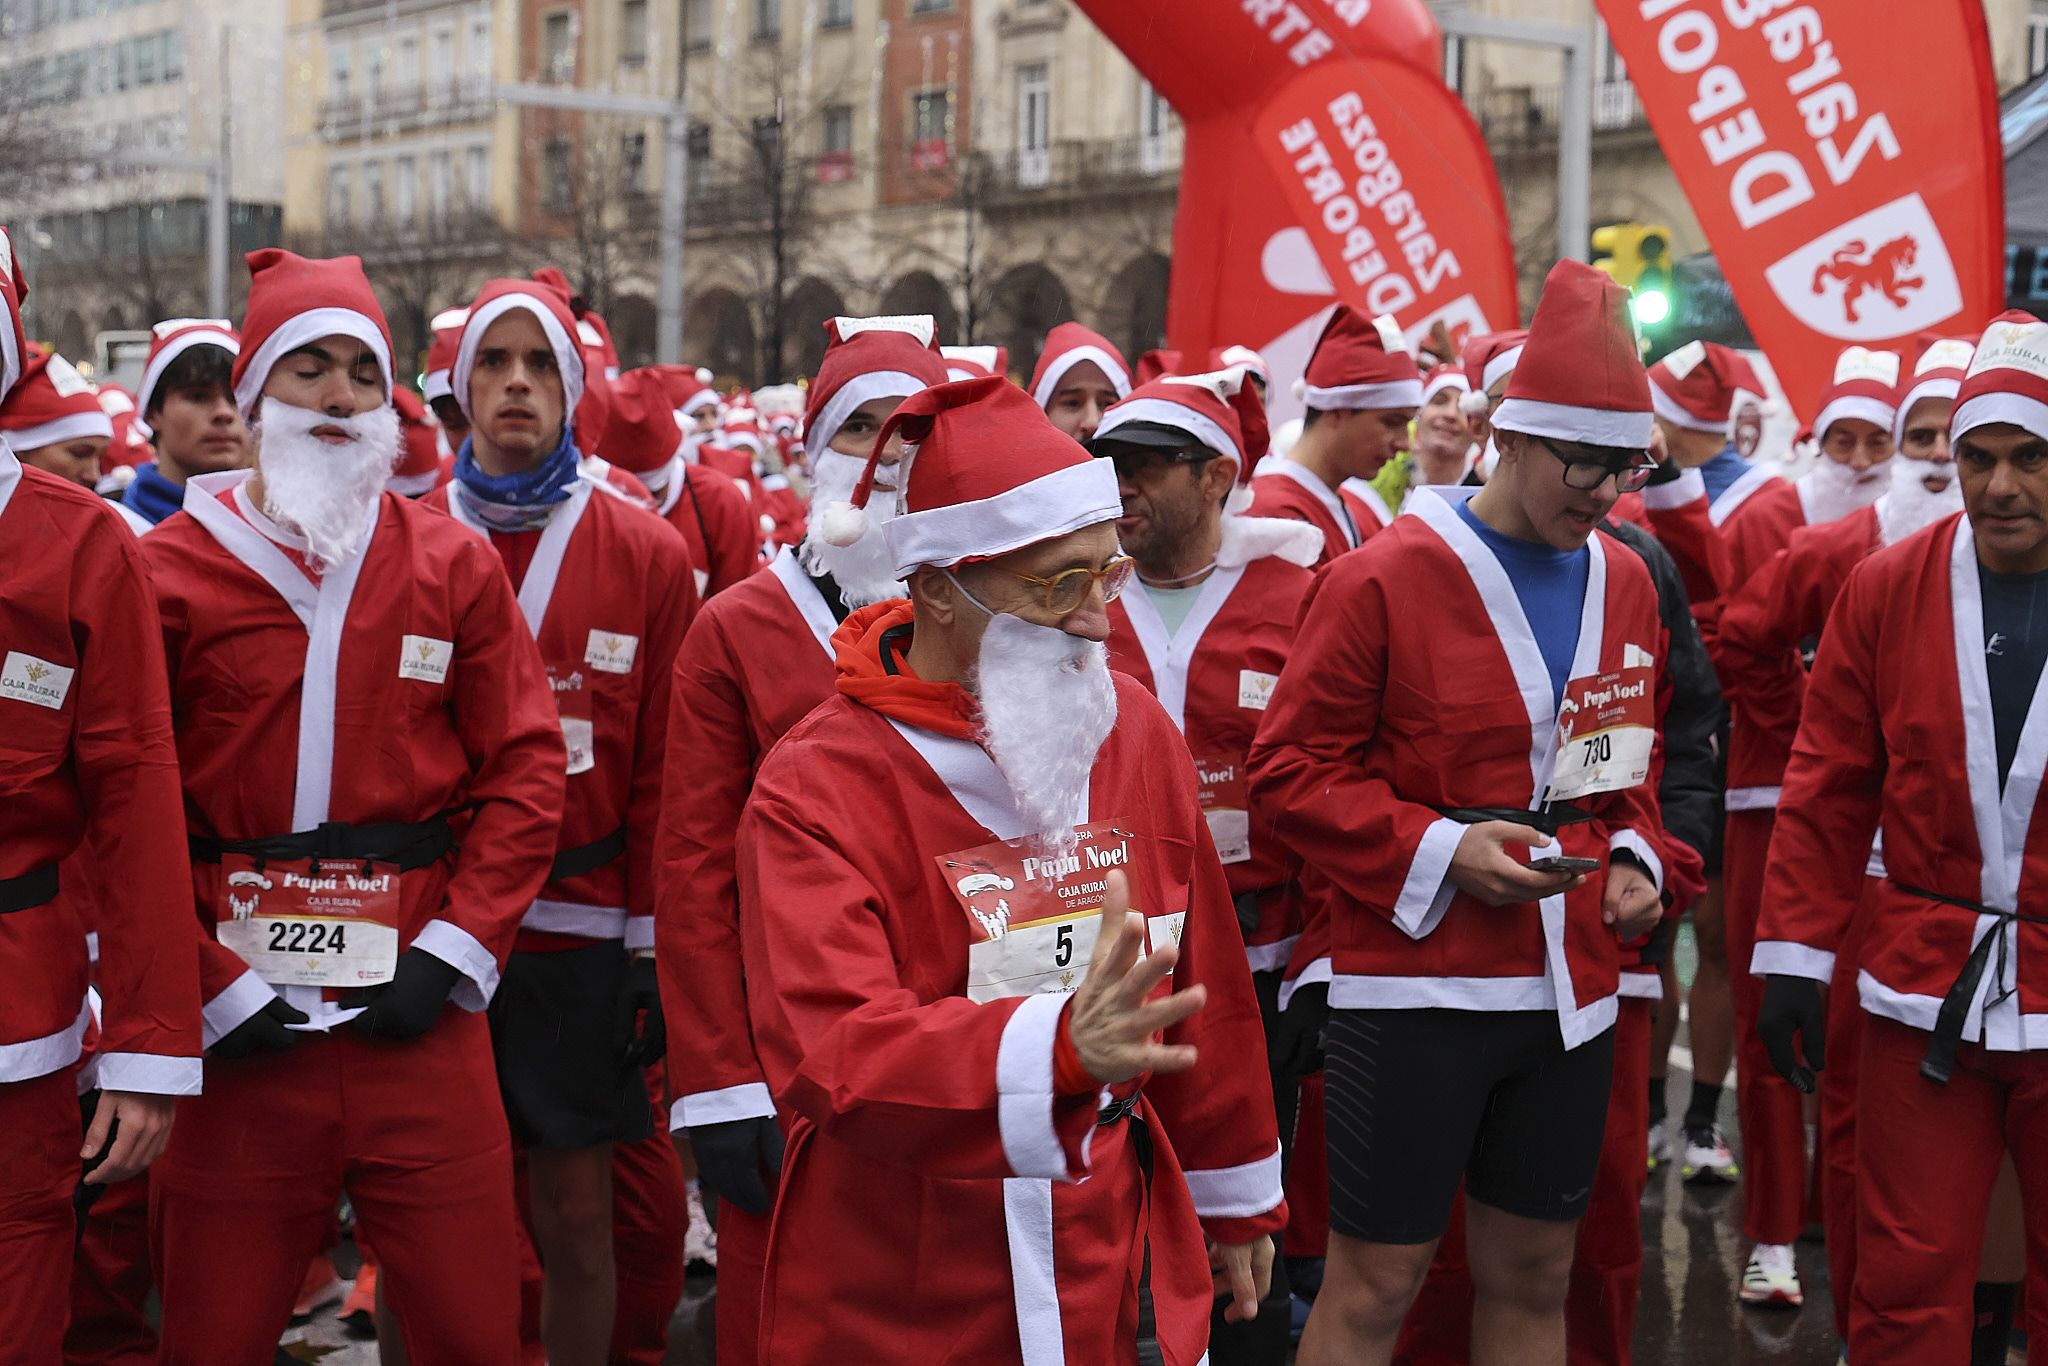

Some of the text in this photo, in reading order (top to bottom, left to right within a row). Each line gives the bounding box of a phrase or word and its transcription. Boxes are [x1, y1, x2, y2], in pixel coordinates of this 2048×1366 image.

[1583, 734, 1611, 767] 730
[1084, 840, 1128, 870] Noel
[282, 872, 390, 893] Papá Noel
[1058, 884, 1081, 898] CAJA
[1066, 900, 1076, 908] DE
[268, 922, 346, 954] 2224
[1055, 924, 1073, 967] 5
